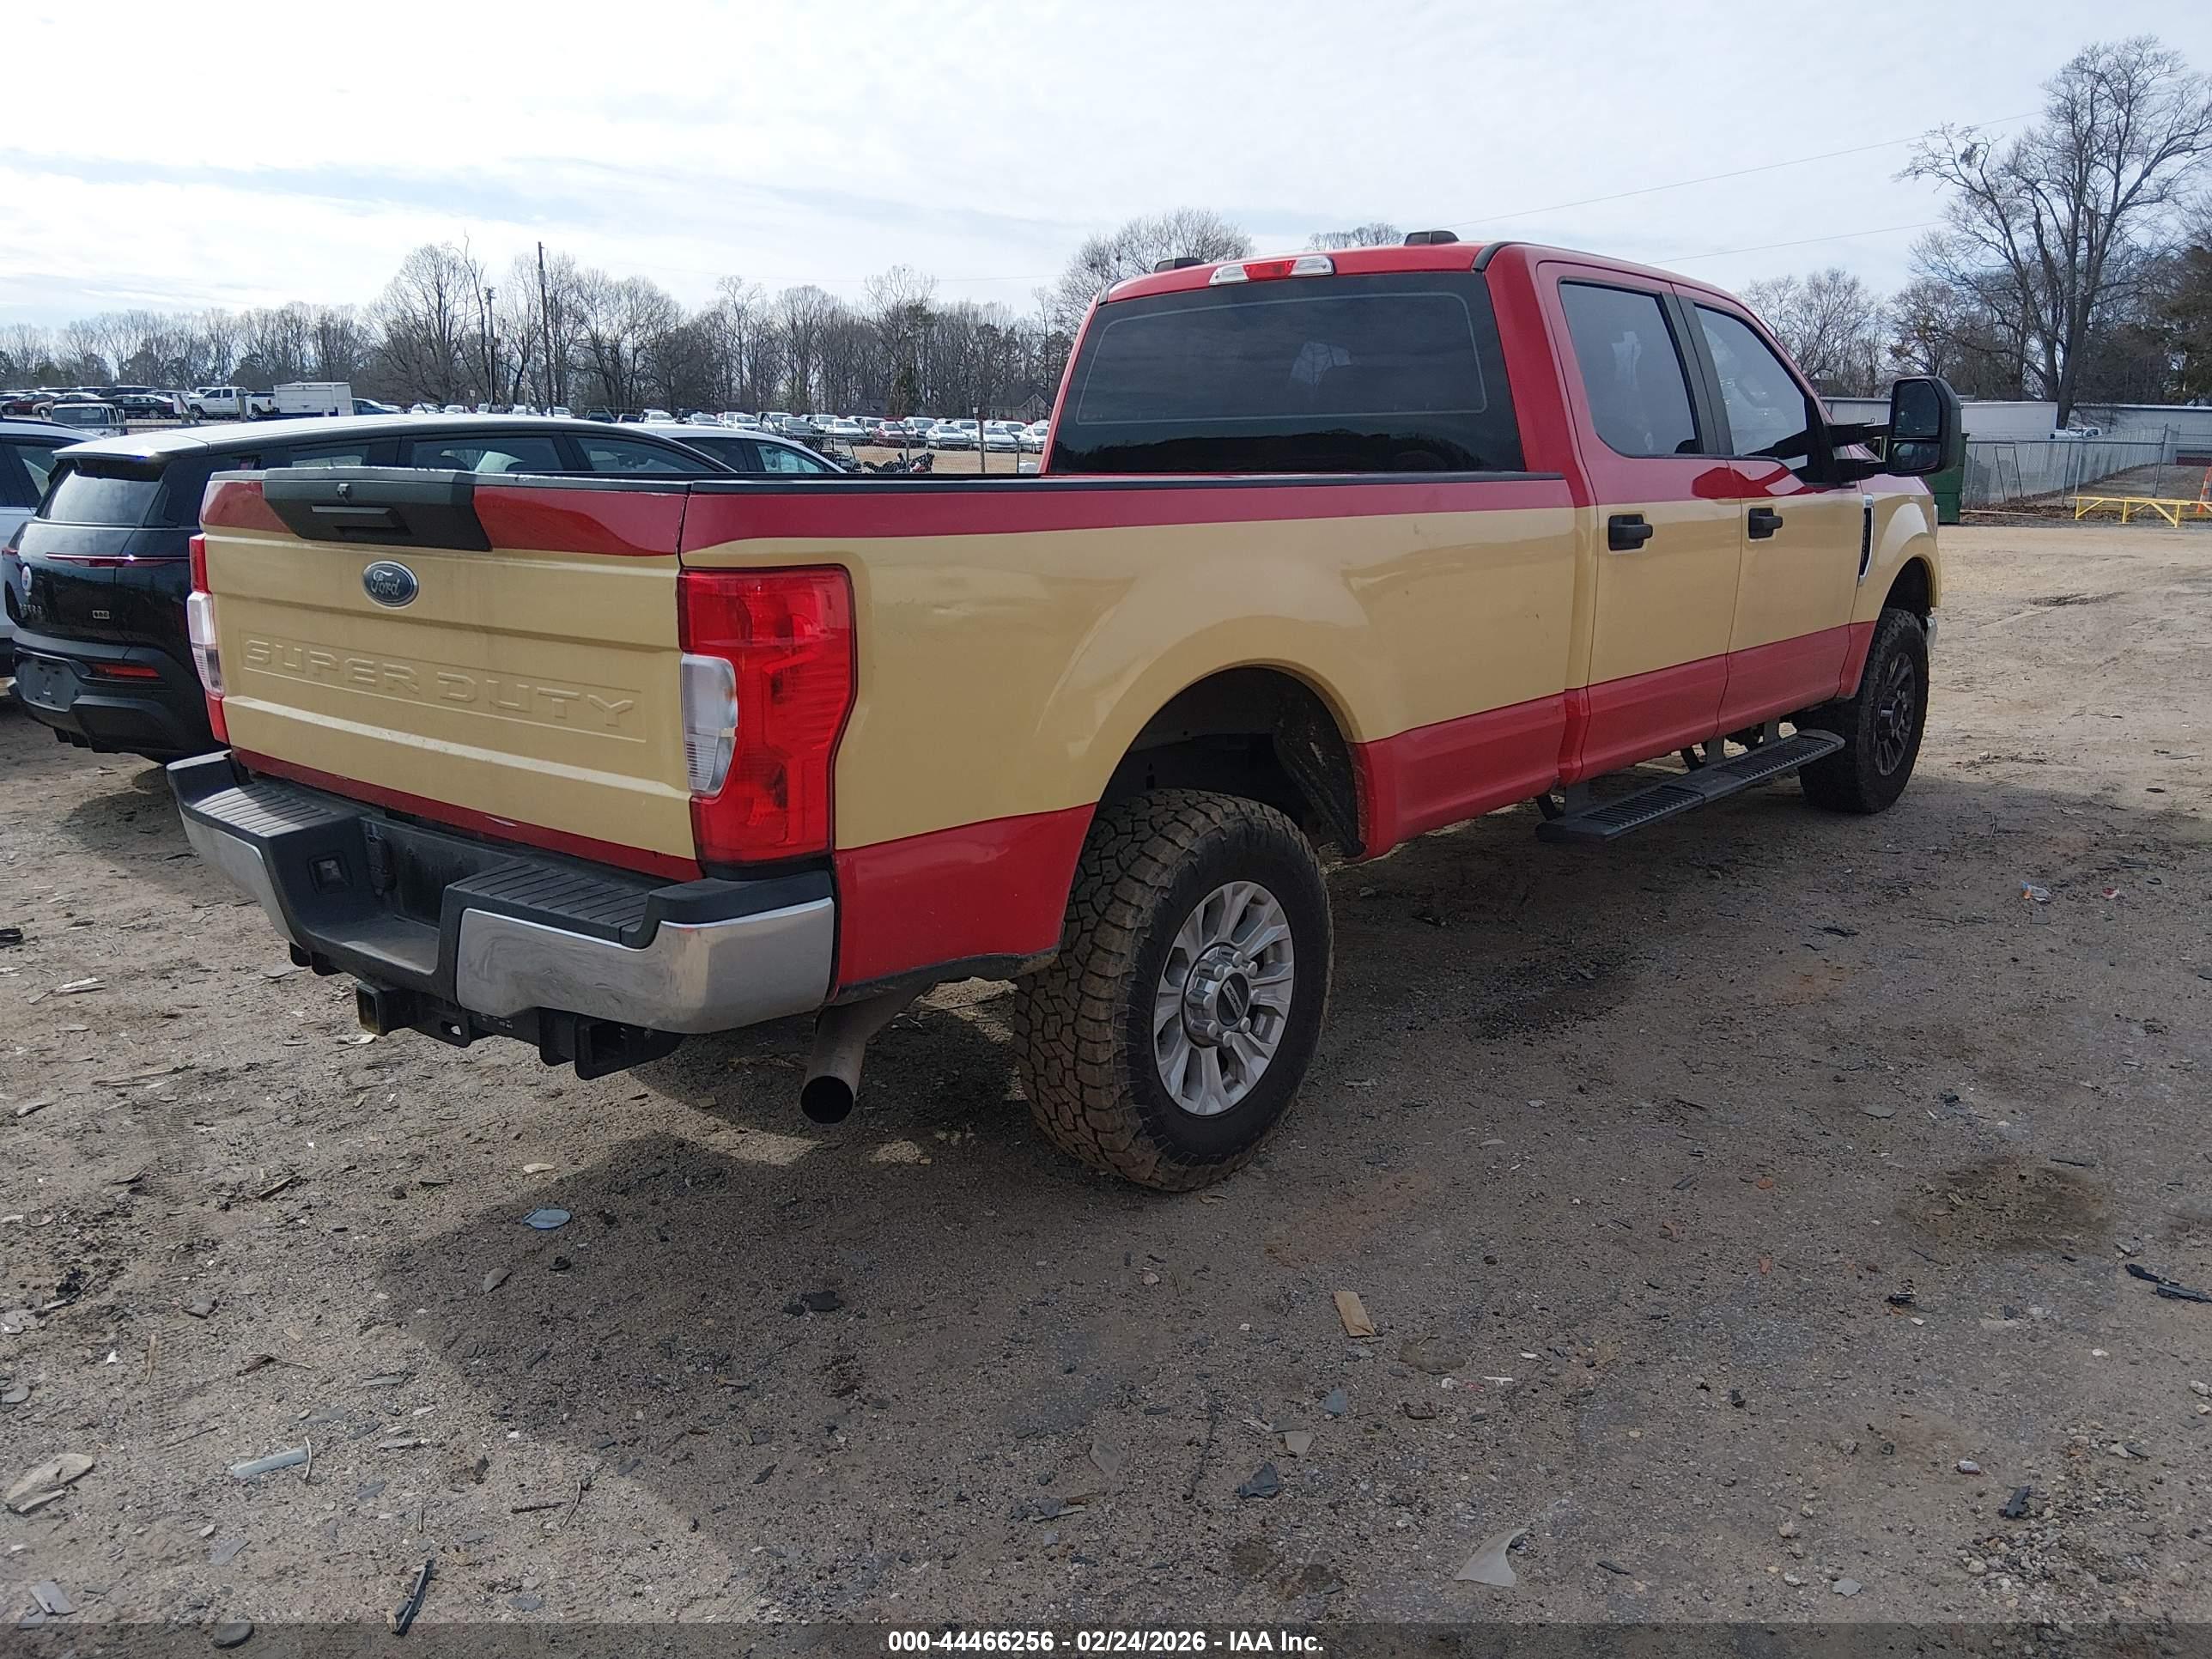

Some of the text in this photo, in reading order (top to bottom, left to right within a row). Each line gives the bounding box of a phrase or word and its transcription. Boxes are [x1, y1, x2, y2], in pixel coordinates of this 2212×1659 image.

[370, 569, 401, 597] Ford
[246, 639, 635, 728] SUPER DUTY
